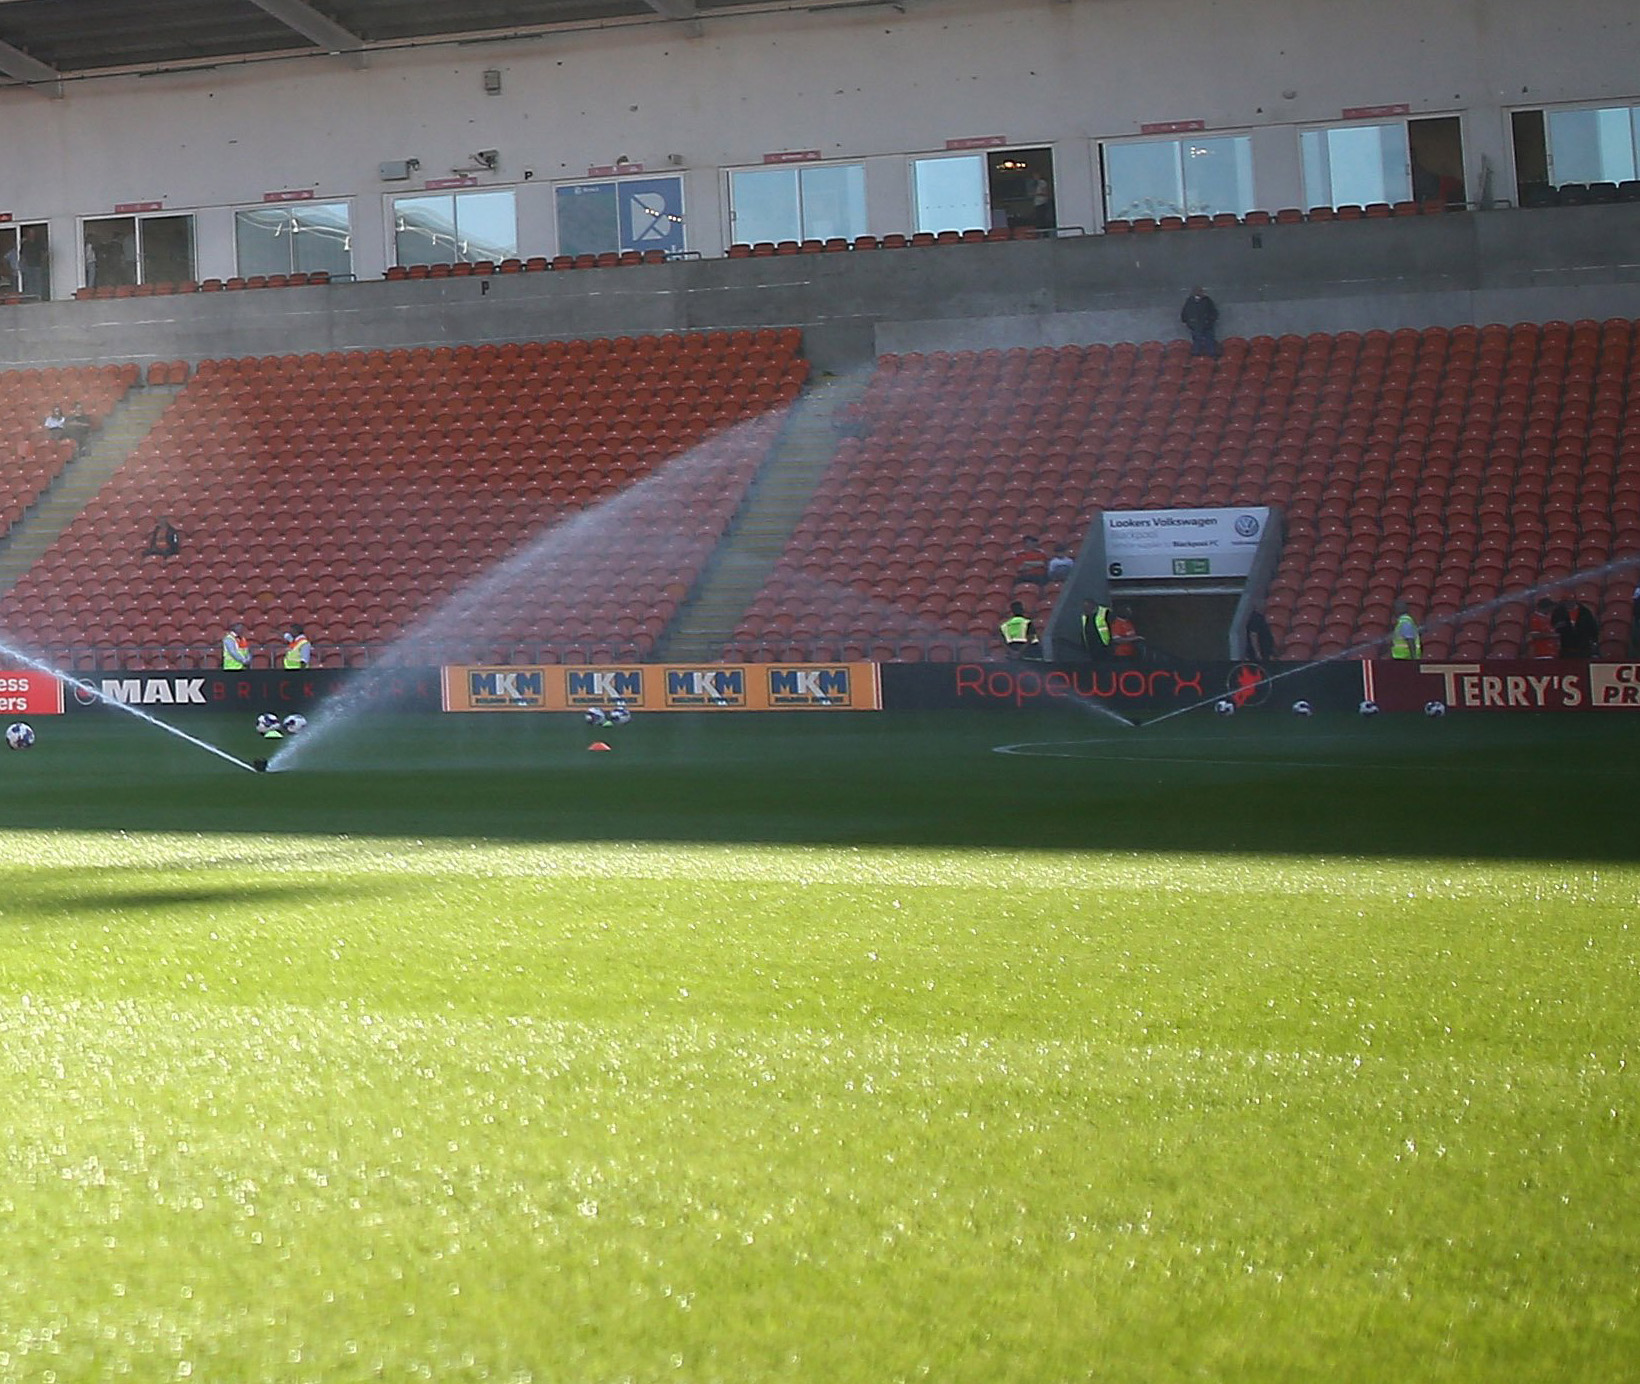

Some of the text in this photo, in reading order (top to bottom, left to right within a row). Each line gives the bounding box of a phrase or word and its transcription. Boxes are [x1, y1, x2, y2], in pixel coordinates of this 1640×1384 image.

[1109, 516, 1218, 528] Lookers Volkswagen
[1109, 562, 1123, 577] 6
[101, 677, 207, 705] MAK
[471, 672, 541, 700] MKM
[570, 671, 641, 700] MKM
[668, 671, 743, 700] MKM
[771, 670, 849, 700] MKM
[955, 664, 1203, 707] Ropeworx
[1420, 664, 1582, 706] TERRY'S
